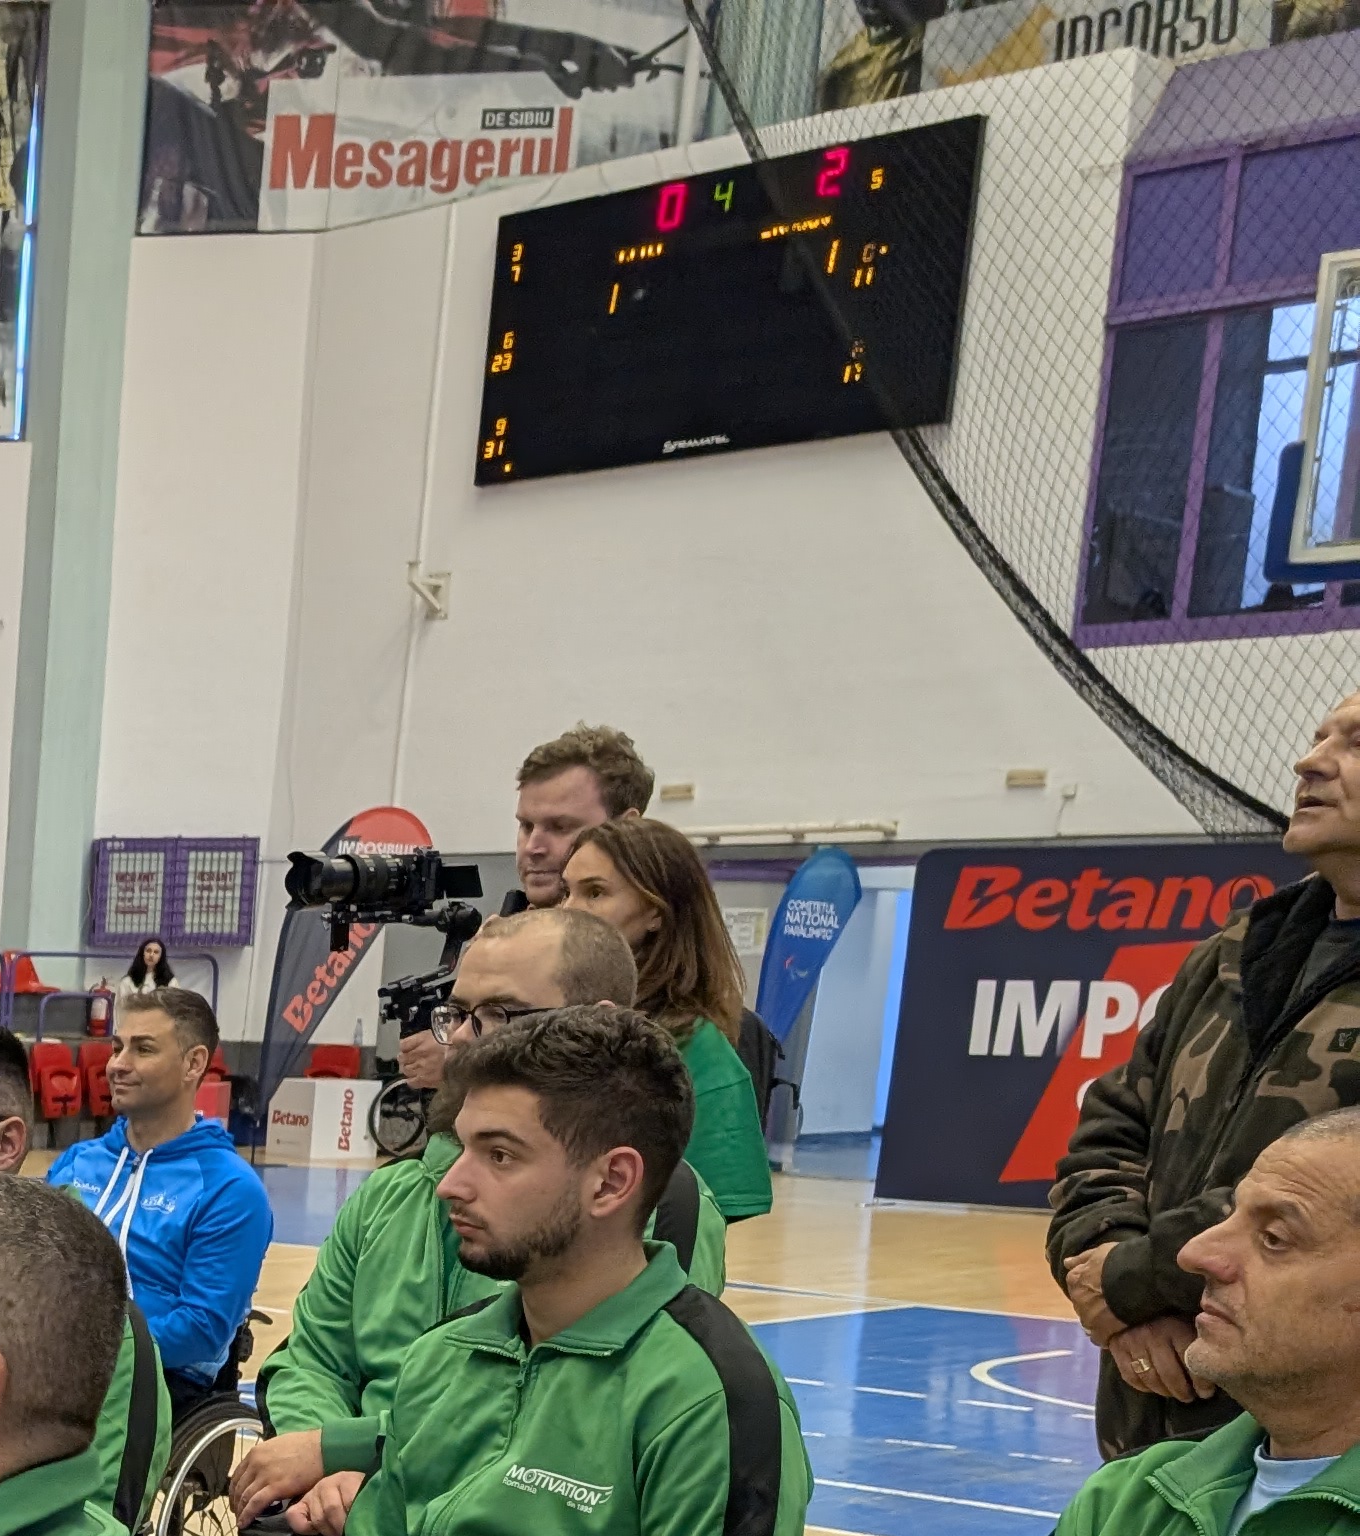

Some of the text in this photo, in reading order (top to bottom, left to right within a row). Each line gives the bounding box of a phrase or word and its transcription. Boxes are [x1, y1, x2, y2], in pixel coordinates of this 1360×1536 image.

[485, 110, 550, 127] DE SIBIU
[269, 106, 574, 194] Mesagerul
[816, 146, 850, 196] 2
[656, 183, 688, 231] 0
[714, 180, 734, 212] 4
[490, 353, 512, 373] 23
[787, 899, 836, 916] COMITETUL
[943, 865, 1276, 932] Betano
[272, 1108, 309, 1127] Betano
[338, 1086, 355, 1152] Betano
[502, 1476, 537, 1495] Romania
[506, 1464, 603, 1506] MOTIVATION
[566, 1500, 576, 1509] din
